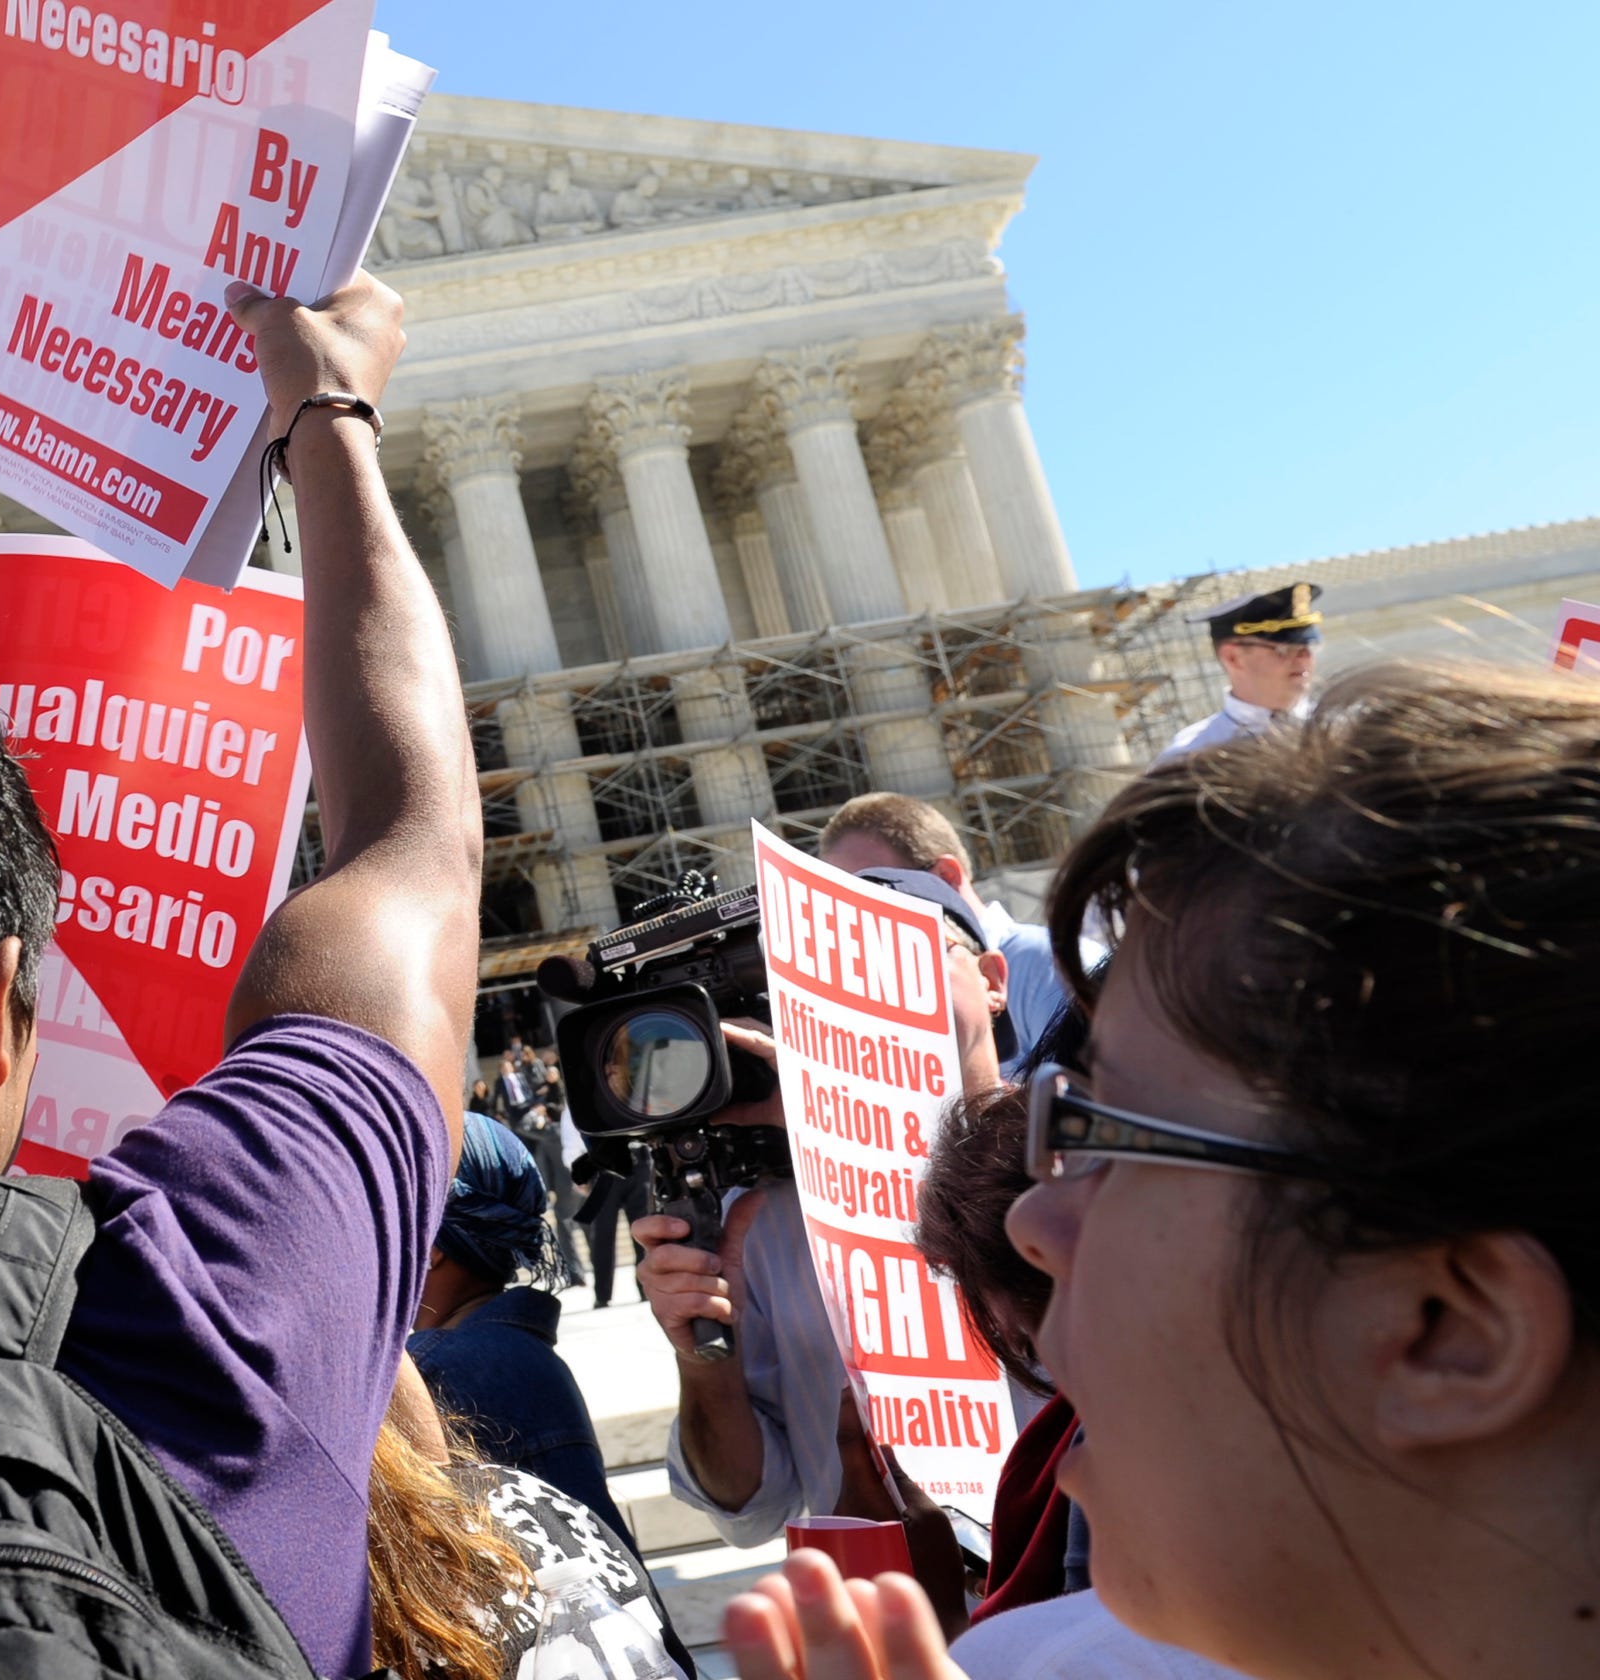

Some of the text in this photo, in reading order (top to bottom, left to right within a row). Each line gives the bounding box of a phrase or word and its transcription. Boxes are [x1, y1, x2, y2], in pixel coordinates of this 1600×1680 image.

[4, 0, 247, 105] Necesario
[248, 128, 318, 229] By
[203, 202, 299, 299] Any
[111, 252, 258, 374] Means
[6, 294, 239, 462] Necessary
[181, 602, 294, 692] Por
[56, 770, 255, 878] Medio
[55, 869, 237, 969] esario
[763, 859, 939, 1017] DEFEND
[779, 989, 945, 1097] Affirmative
[801, 1069, 930, 1160] Action &
[795, 1131, 926, 1224] Integrati
[815, 1234, 967, 1362] FIGHT
[868, 1389, 1001, 1454] quality
[929, 1480, 984, 1495] 438-3748
